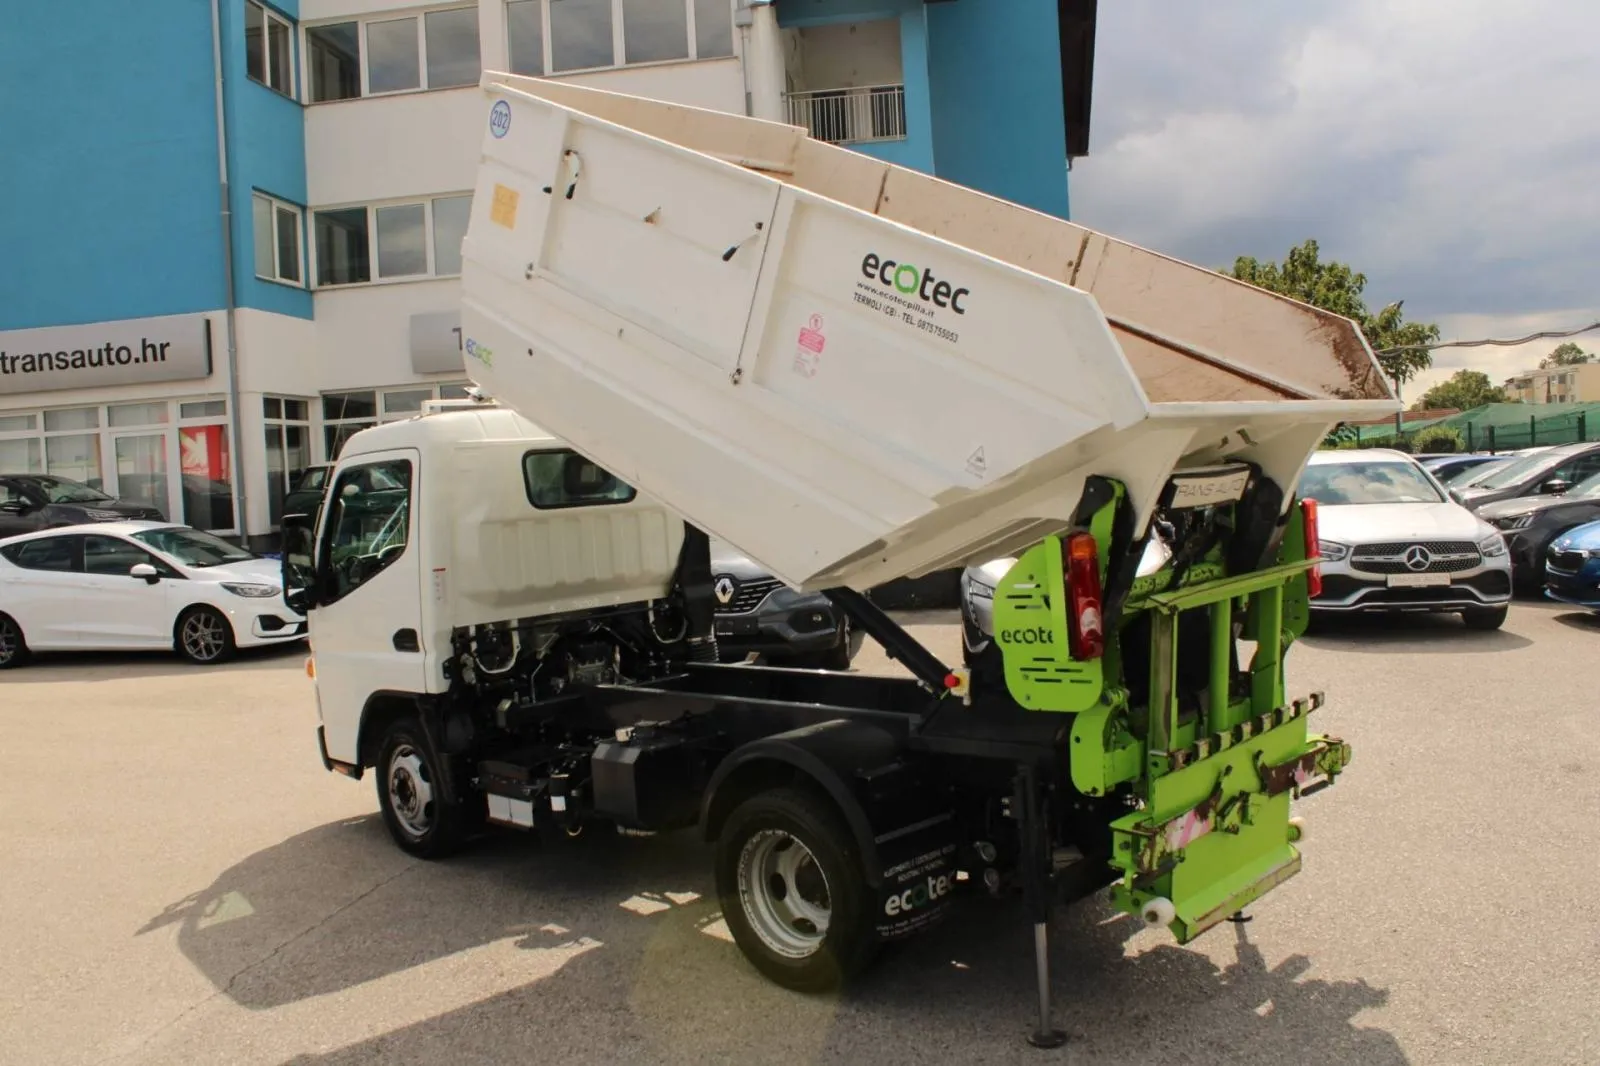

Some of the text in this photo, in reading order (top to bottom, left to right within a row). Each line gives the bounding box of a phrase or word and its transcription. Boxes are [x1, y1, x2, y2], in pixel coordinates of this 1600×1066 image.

[492, 110, 508, 128] 202
[853, 291, 881, 311] TERMOLI
[856, 281, 935, 318] www.ecotecpilla.it
[861, 252, 970, 315] ecotec
[0, 337, 171, 375] transauto.hr
